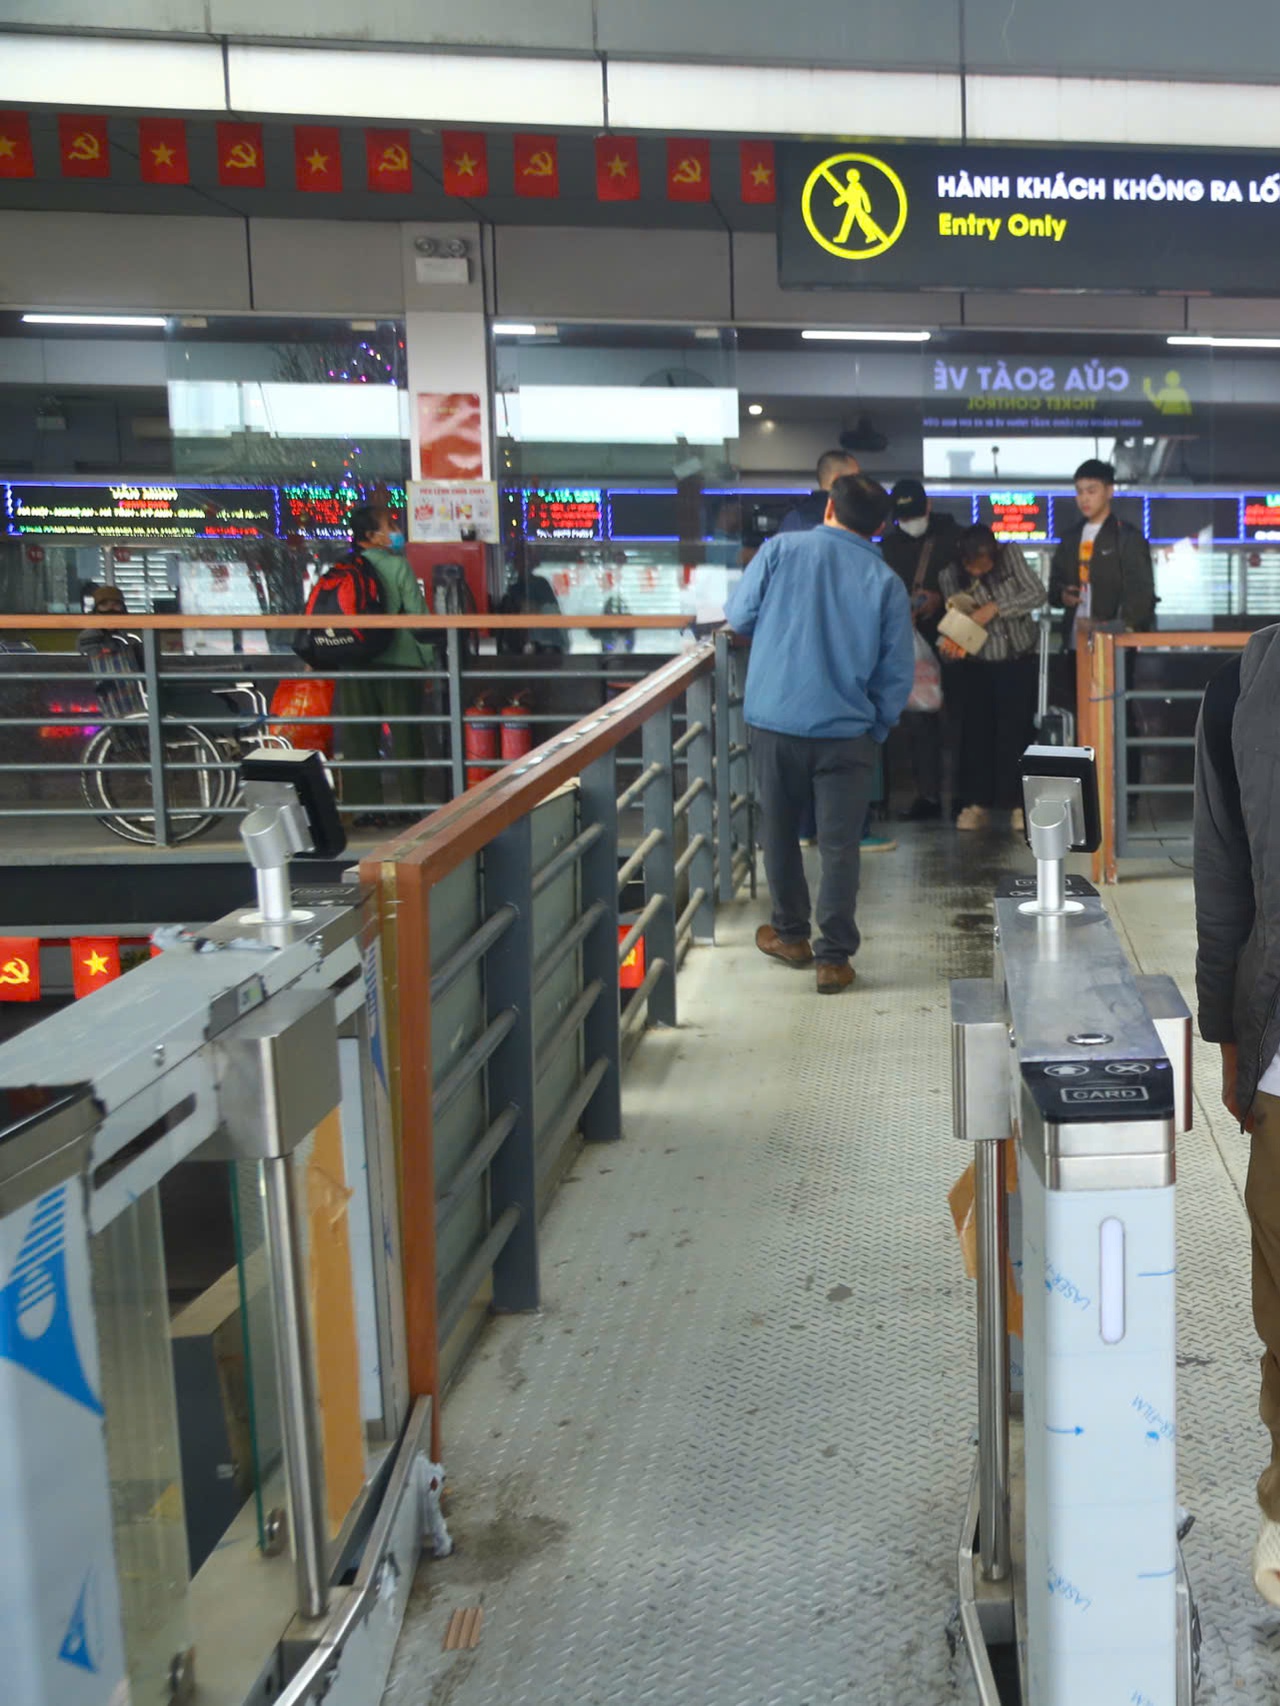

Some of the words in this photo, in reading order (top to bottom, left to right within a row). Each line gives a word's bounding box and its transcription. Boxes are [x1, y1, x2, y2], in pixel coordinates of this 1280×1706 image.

[938, 170, 1008, 199] HÀNH
[1017, 173, 1106, 200] KHÁCH
[1113, 174, 1205, 202] KHÔNG
[1211, 181, 1244, 203] RA
[939, 213, 1002, 240] Entry
[1008, 213, 1067, 242] Only
[314, 636, 355, 646] iPhone
[1073, 1088, 1138, 1100] CARD
